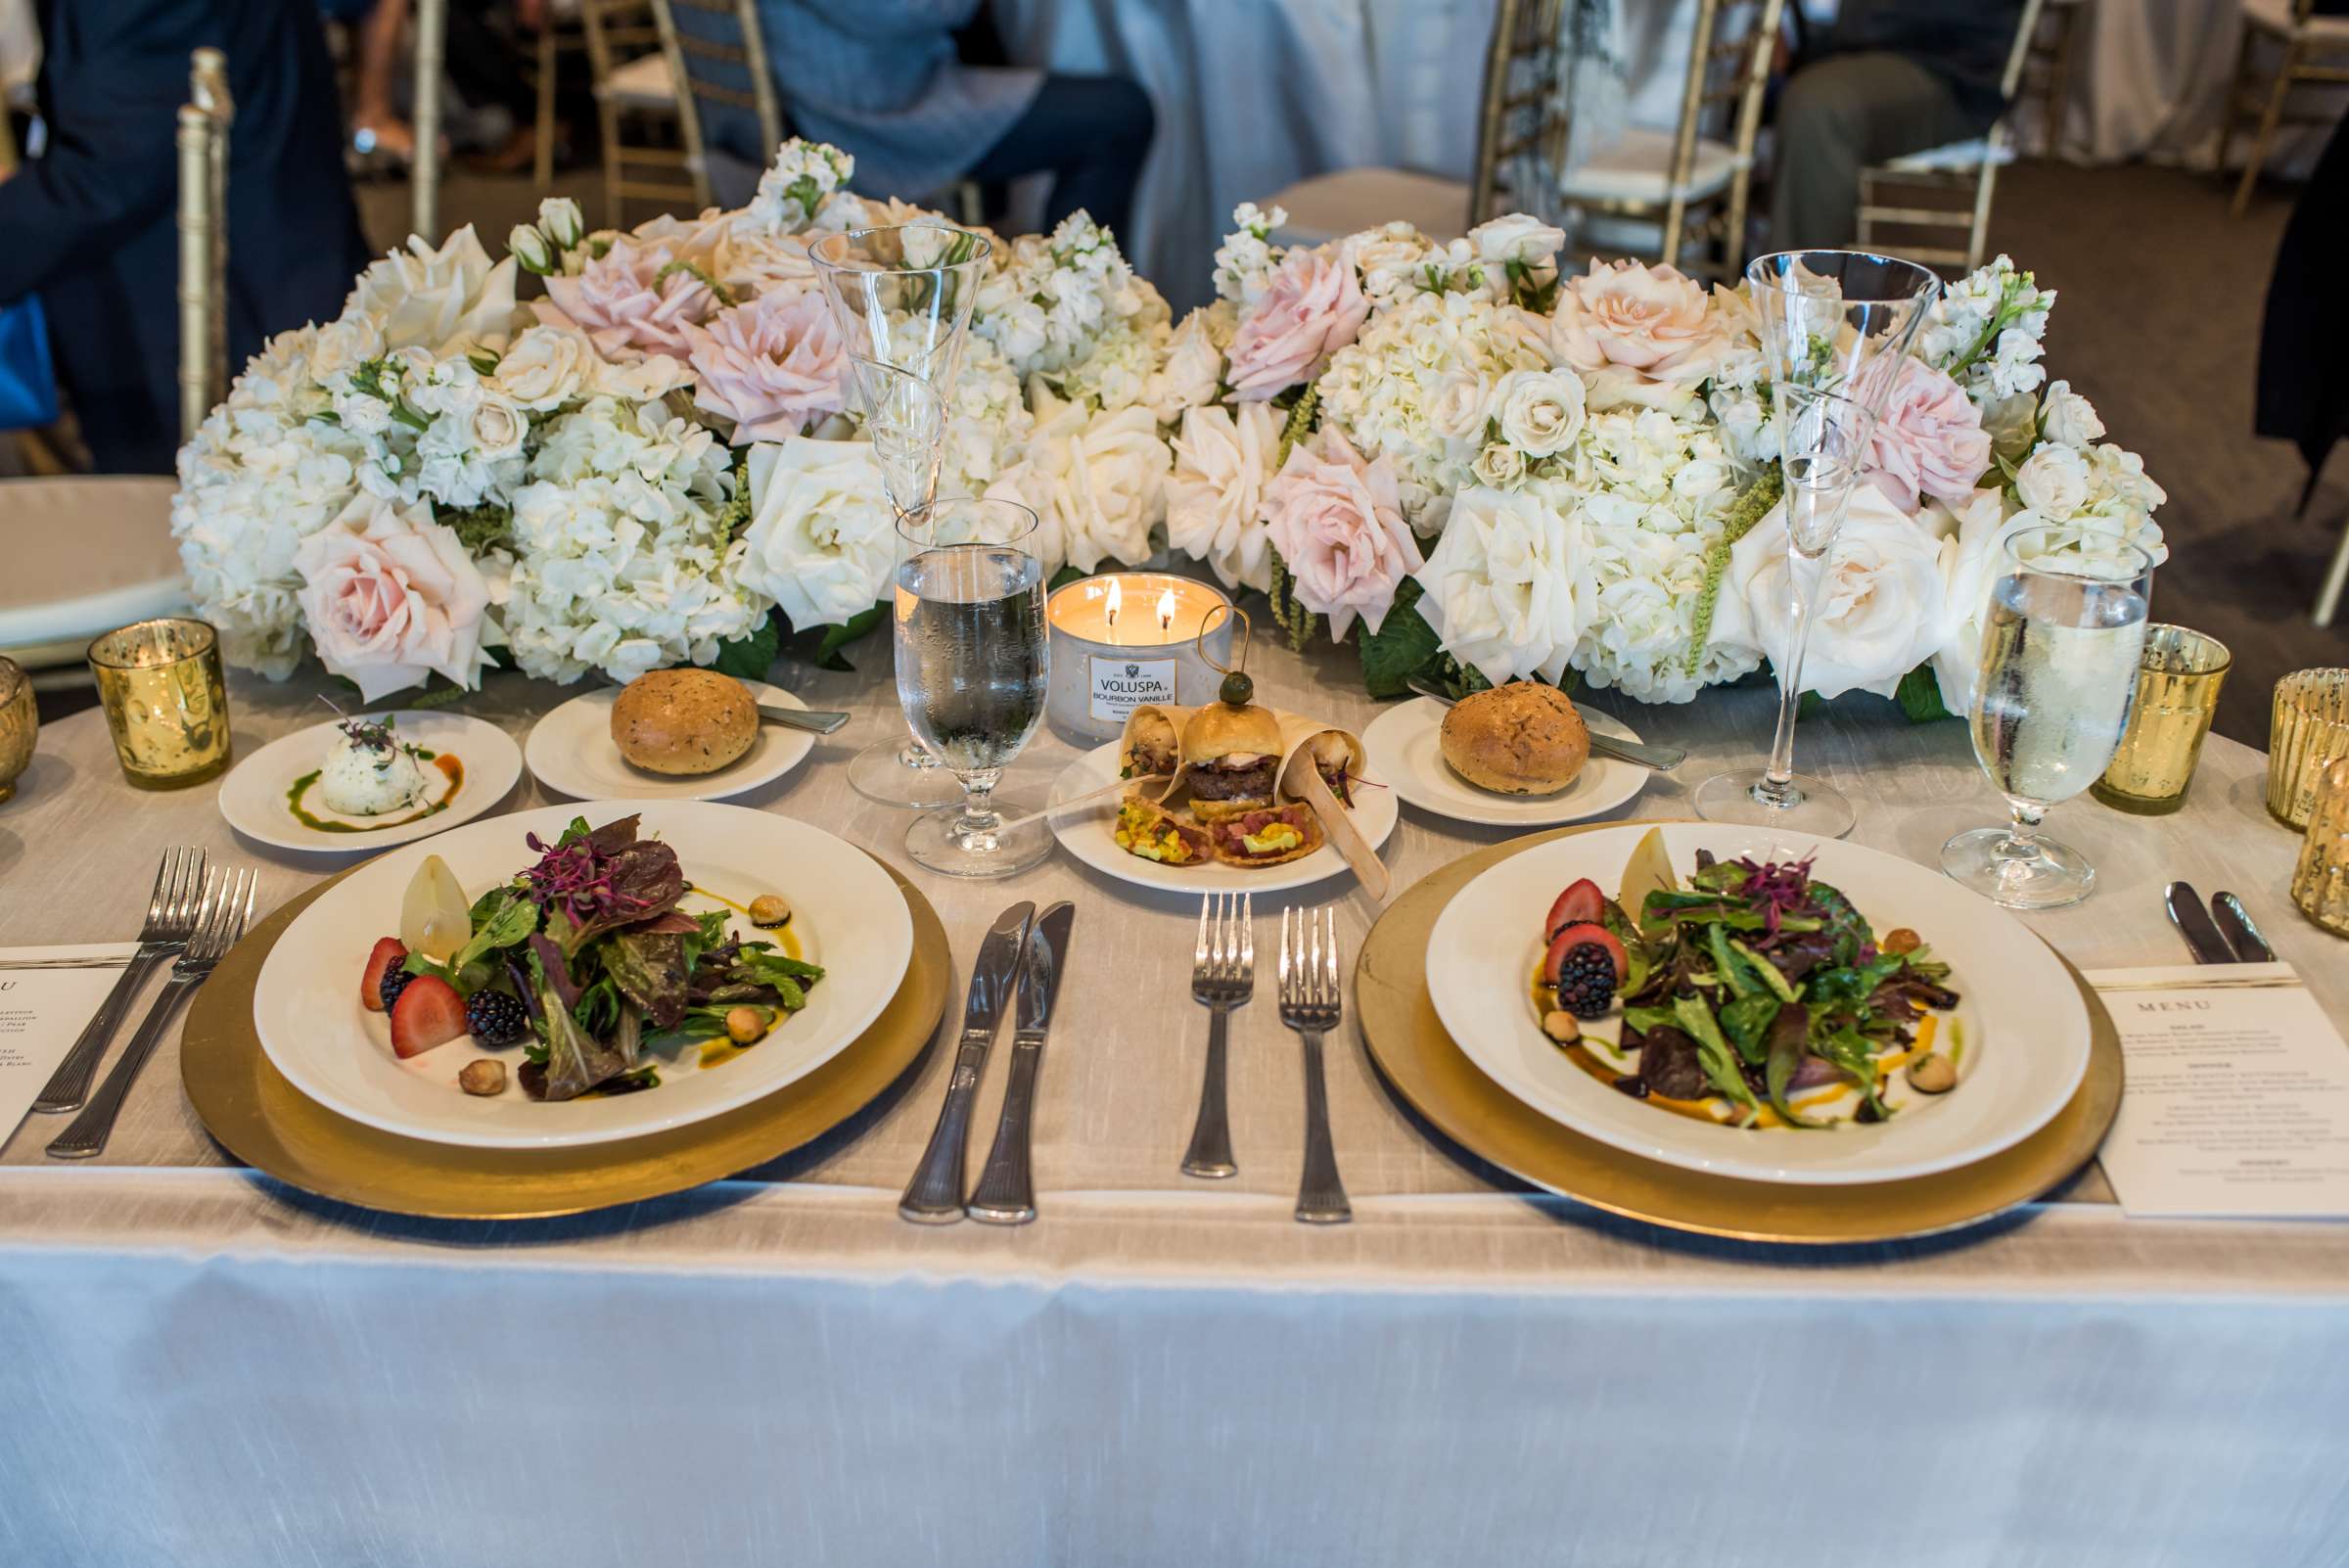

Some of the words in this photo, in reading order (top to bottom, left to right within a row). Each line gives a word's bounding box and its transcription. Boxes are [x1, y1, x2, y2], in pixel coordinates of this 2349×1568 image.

[1100, 679, 1163, 693] VOLUSPA
[1093, 692, 1136, 703] BOURBON
[1137, 693, 1173, 703] VANILLE
[2137, 1000, 2211, 1012] MENU
